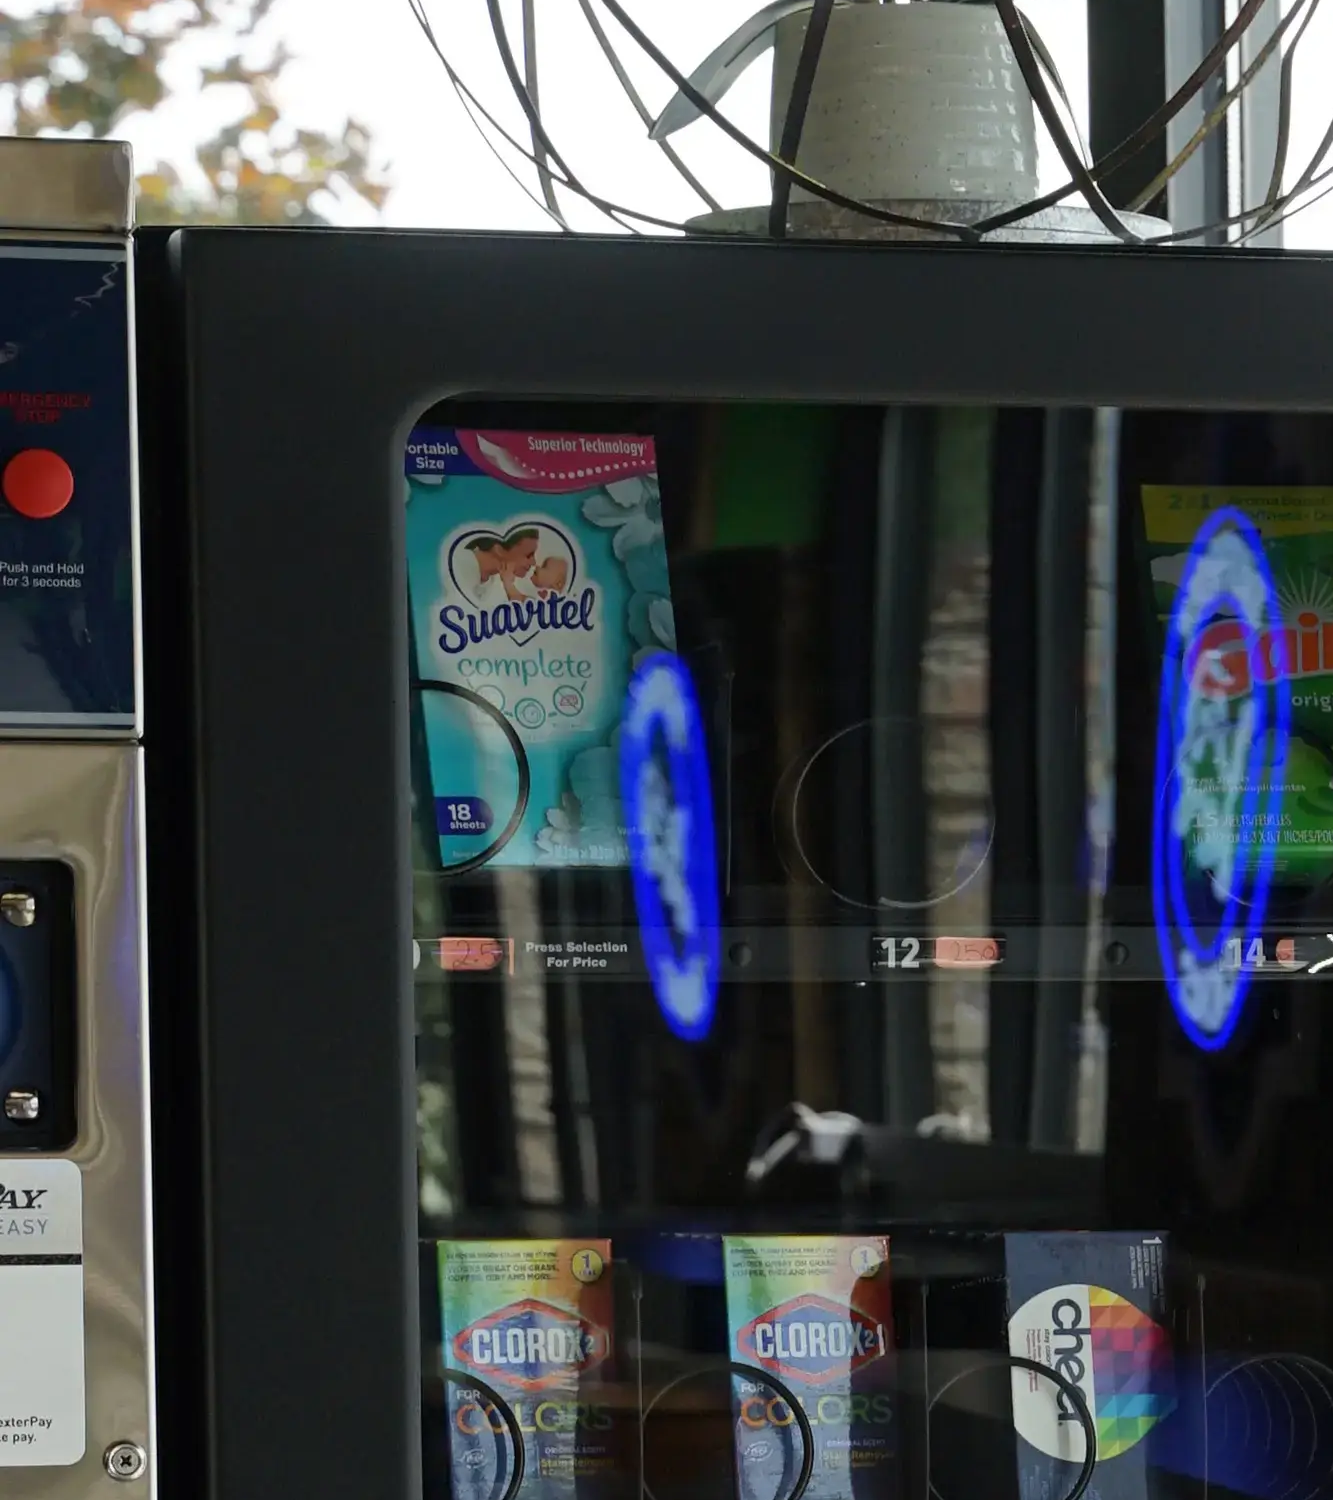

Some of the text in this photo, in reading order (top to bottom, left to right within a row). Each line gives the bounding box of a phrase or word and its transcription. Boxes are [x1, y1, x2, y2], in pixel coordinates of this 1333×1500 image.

[405, 443, 459, 456] ortable
[527, 436, 644, 456] Superior Technology
[416, 456, 445, 470] Size
[0, 561, 84, 575] Push and Hold
[3, 576, 82, 588] for 3 seconds
[438, 587, 595, 654] Suavitel
[457, 649, 592, 686] complete
[448, 804, 471, 820] 18
[450, 820, 486, 830] sheets
[525, 942, 628, 953] Press Selection
[881, 937, 920, 968] 12
[1227, 938, 1266, 968] 14
[547, 956, 607, 968] For Price
[471, 1327, 585, 1365] CLOROX
[755, 1322, 874, 1359] CLOROX 2
[457, 1389, 481, 1400] FOR
[741, 1384, 764, 1393] FOR
[456, 1401, 612, 1435] COLORS
[741, 1395, 893, 1430] COLORS
[12, 1431, 37, 1443] pay.
